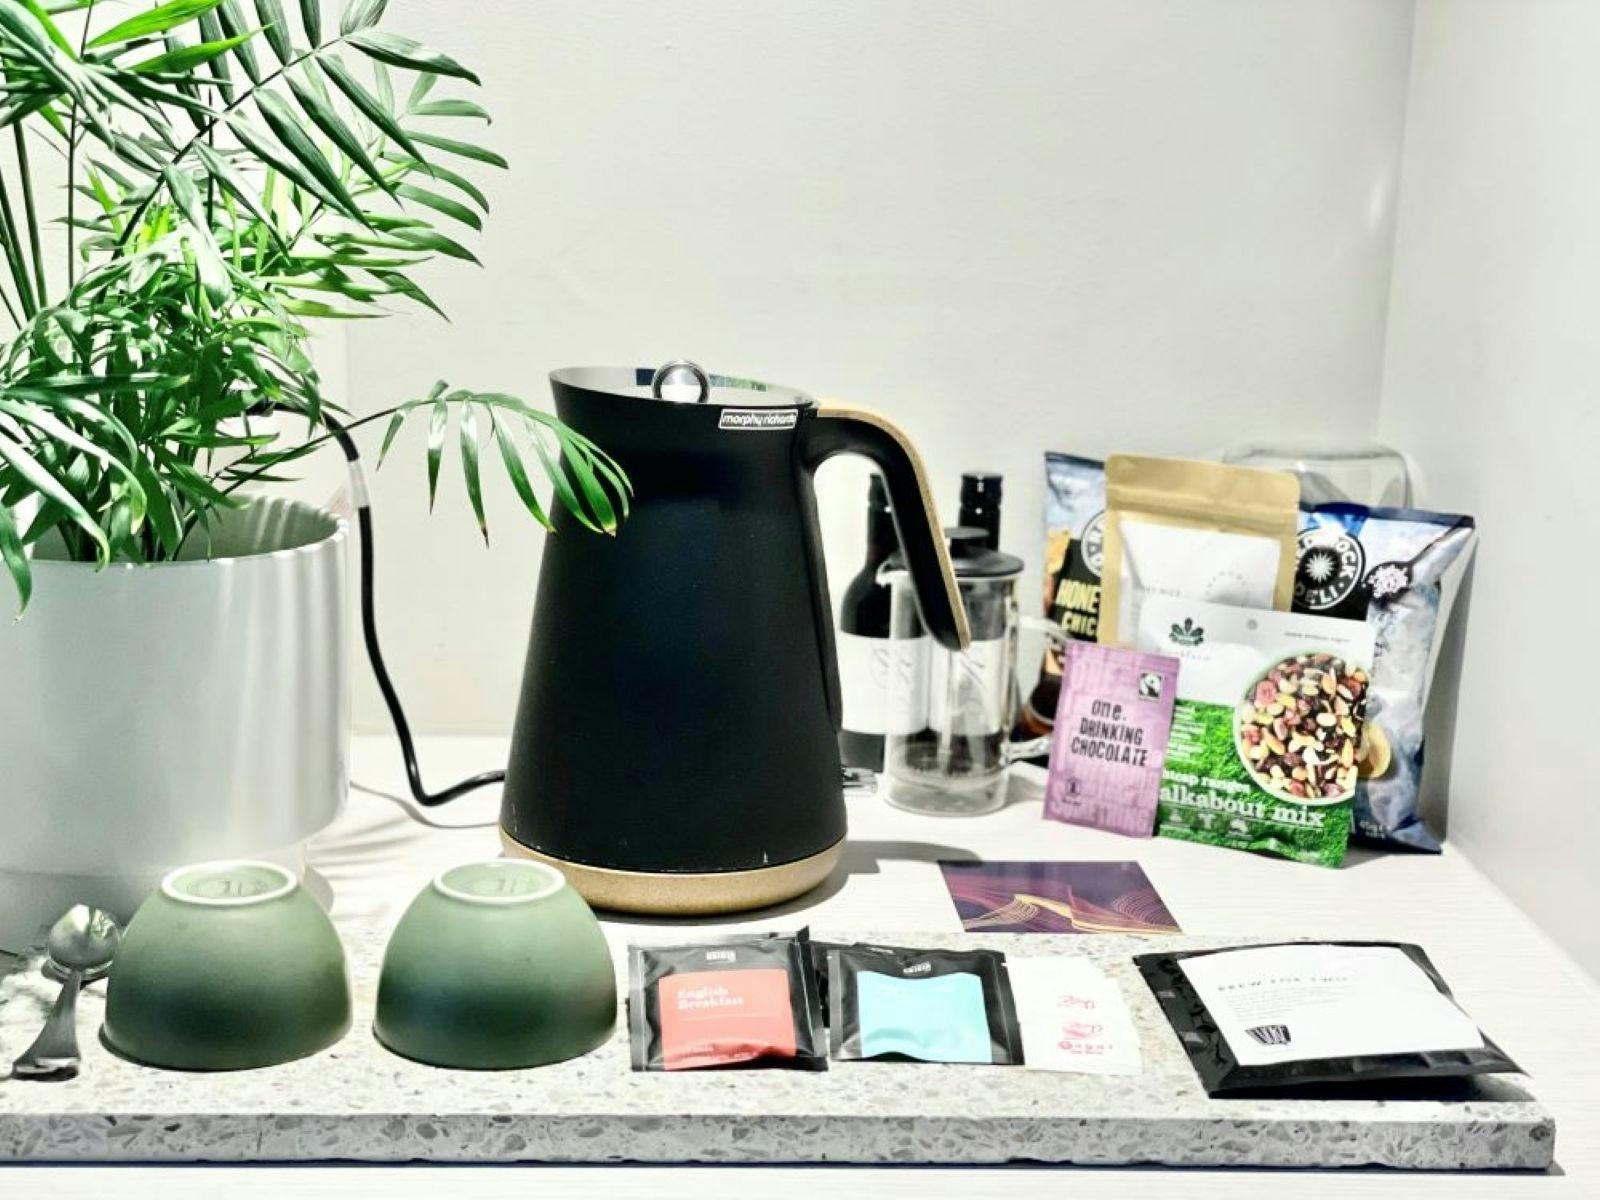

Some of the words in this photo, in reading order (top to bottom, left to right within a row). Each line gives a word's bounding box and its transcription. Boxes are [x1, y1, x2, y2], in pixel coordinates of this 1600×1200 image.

[1055, 578, 1101, 613] HONE
[1061, 610, 1099, 637] CHIC
[1079, 717, 1145, 746] DRINKING
[1070, 736, 1149, 768] CHOCOLATE
[1159, 784, 1266, 819] alkabout
[1271, 804, 1327, 828] mix
[677, 987, 729, 1000] English
[677, 996, 743, 1010] Breakfast
